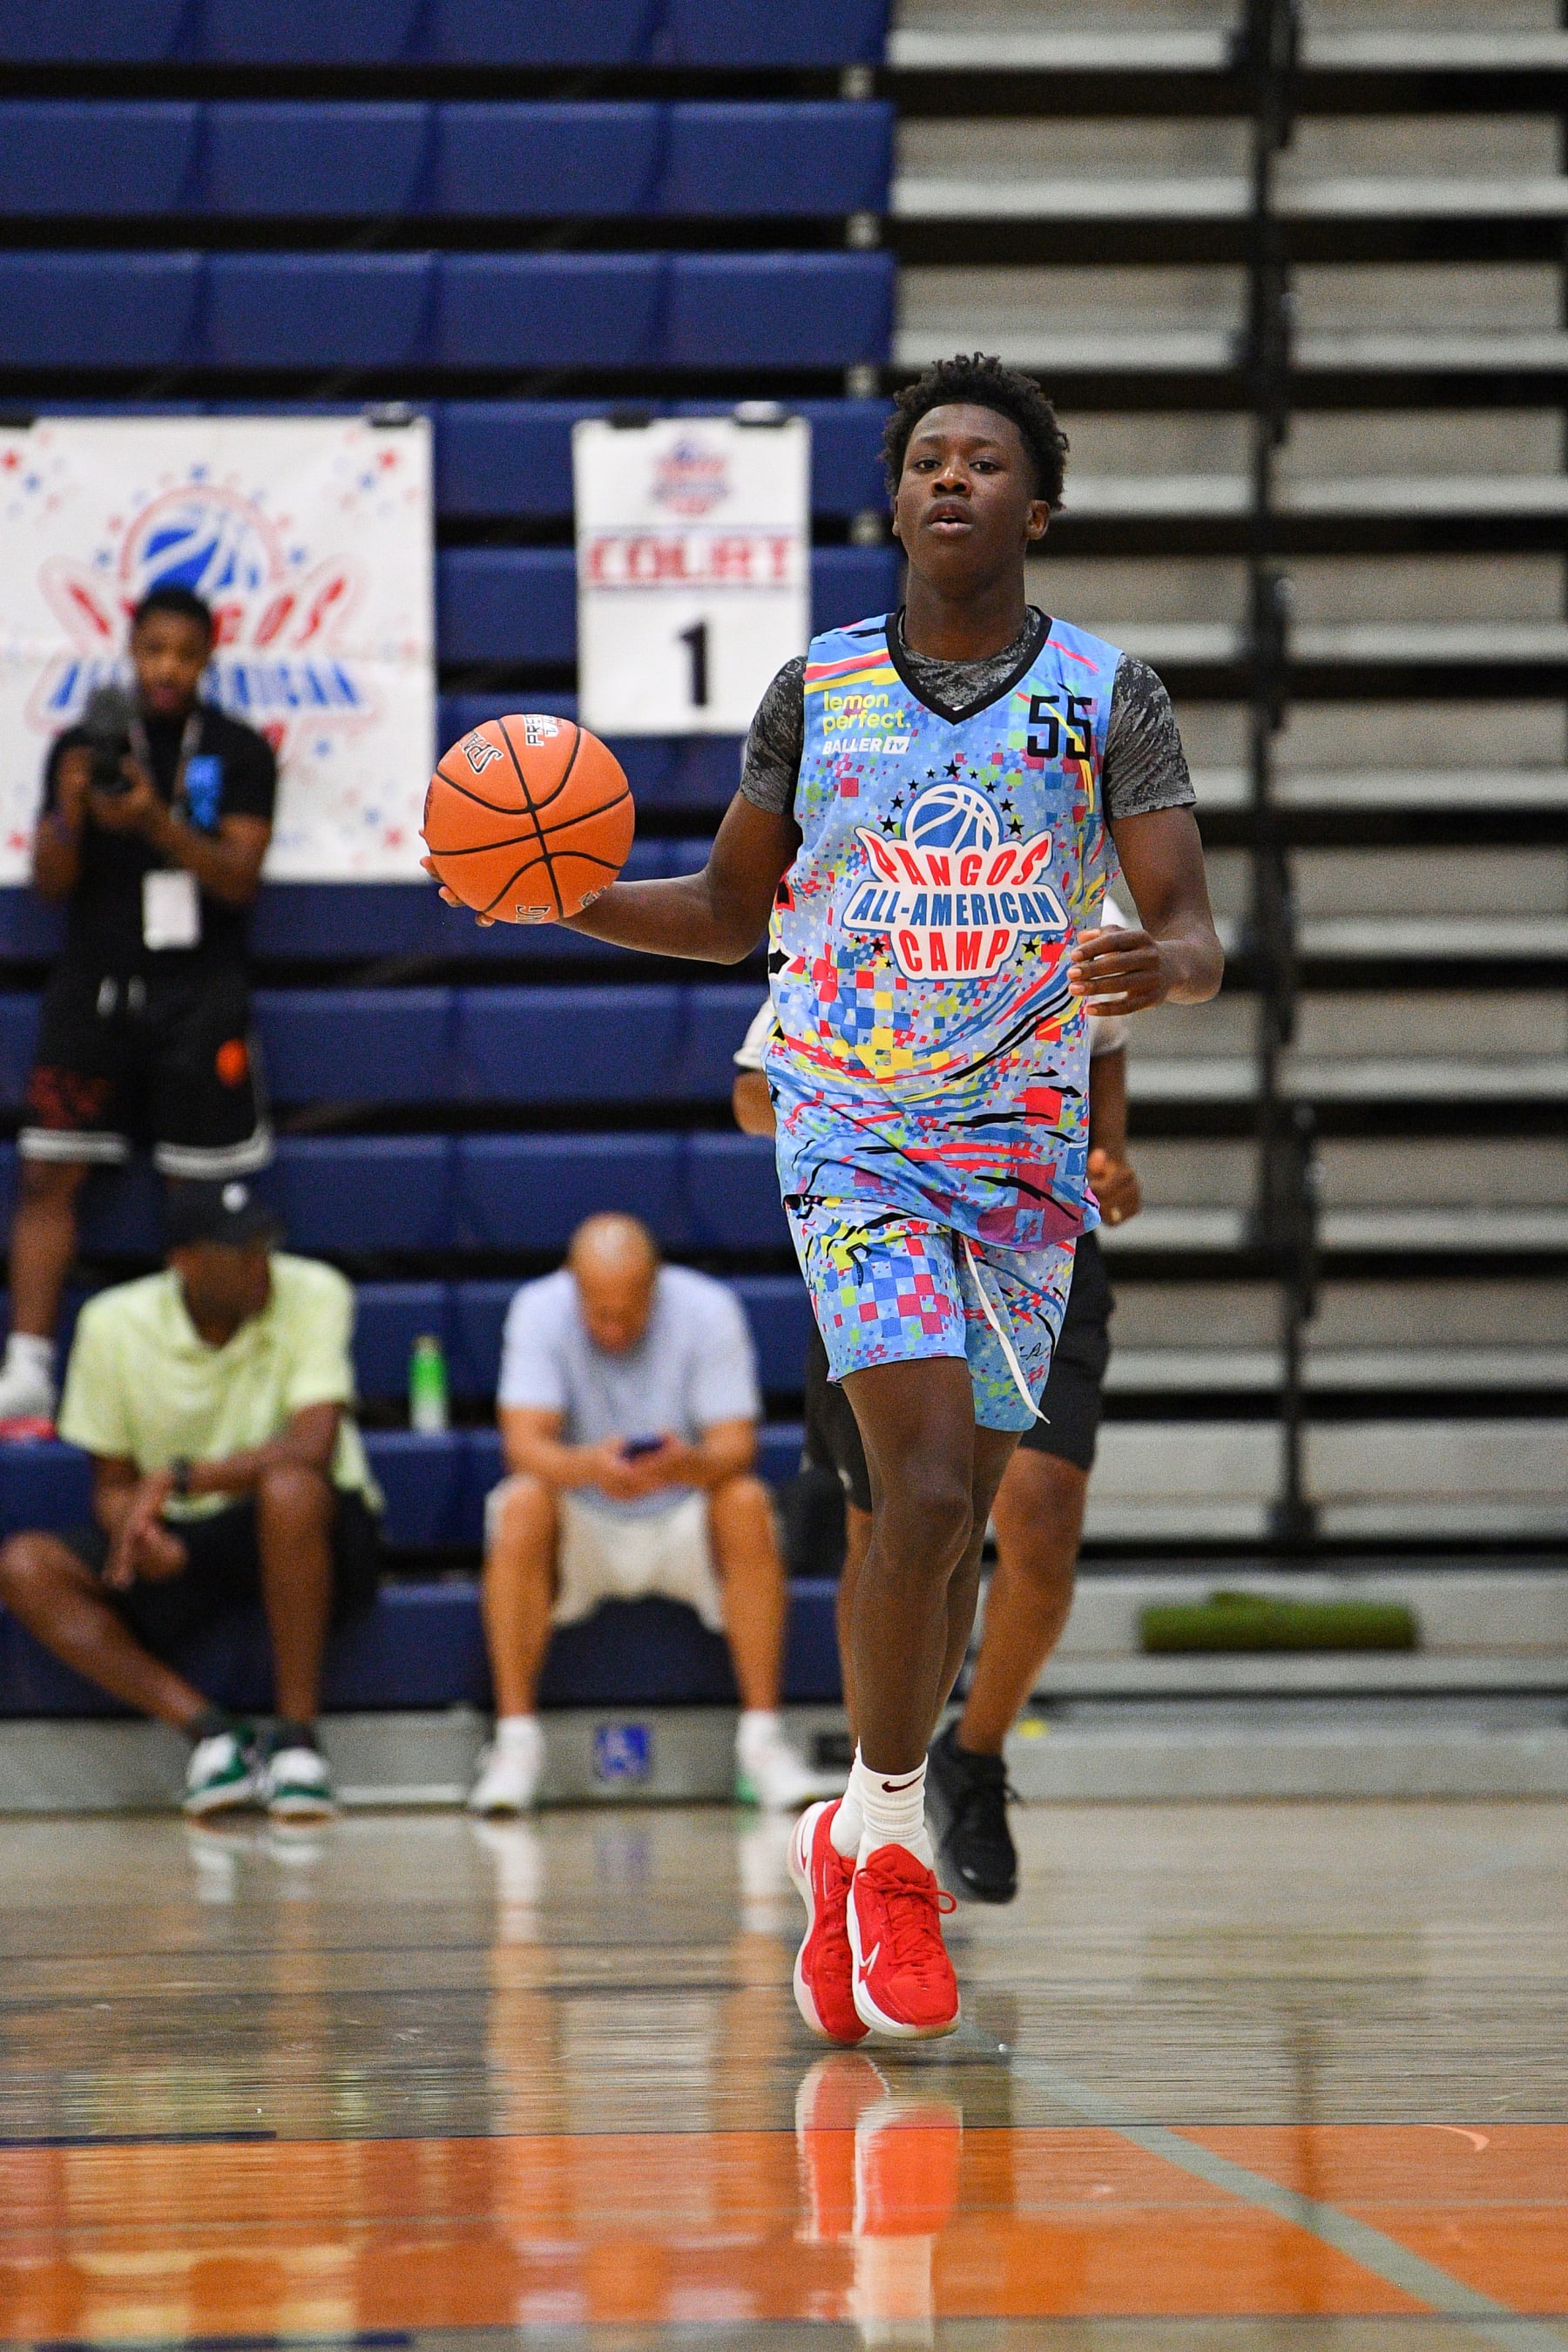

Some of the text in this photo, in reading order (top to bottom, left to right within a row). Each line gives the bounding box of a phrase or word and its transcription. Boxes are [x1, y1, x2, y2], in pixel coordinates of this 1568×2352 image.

[678, 617, 710, 708] 1
[823, 691, 889, 712] lemon
[822, 709, 911, 736] perfect.
[1026, 694, 1092, 760] 55
[821, 738, 883, 755] BALLER
[864, 834, 1049, 887] PANGOS
[850, 889, 1060, 927] ALL-AMERICAN
[898, 929, 1010, 972] CAMP
